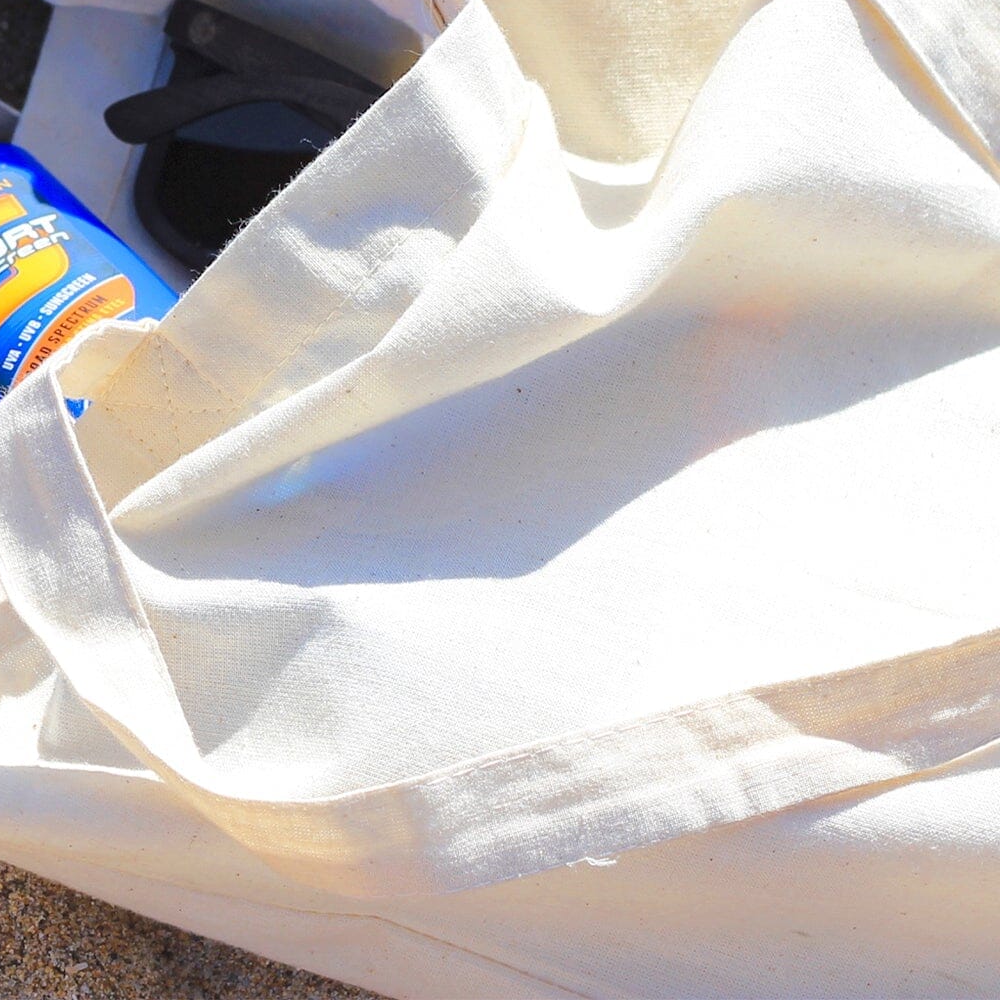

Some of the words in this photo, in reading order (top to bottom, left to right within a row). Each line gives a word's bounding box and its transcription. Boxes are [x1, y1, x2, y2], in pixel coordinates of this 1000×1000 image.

[2, 348, 22, 371] UVA
[19, 319, 42, 343] UVB
[40, 272, 97, 316] SUNSCREEN
[26, 345, 52, 376] OAD
[48, 294, 108, 344] SPECTRUM
